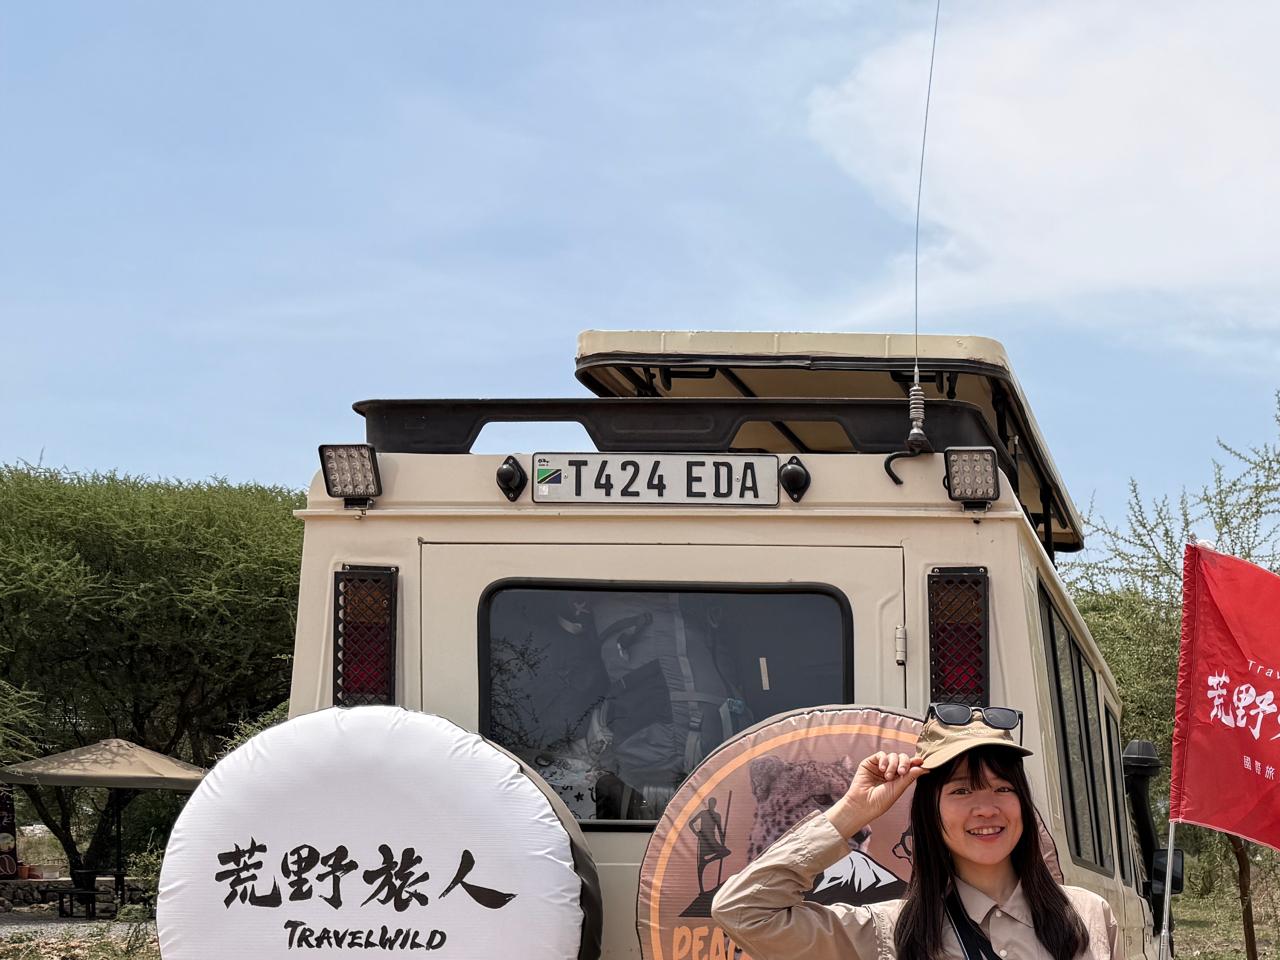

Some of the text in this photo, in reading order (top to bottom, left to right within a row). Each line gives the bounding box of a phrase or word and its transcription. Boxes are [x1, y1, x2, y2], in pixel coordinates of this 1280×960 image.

[567, 459, 760, 499] T424 EDA
[214, 837, 519, 913] 荒野旅人
